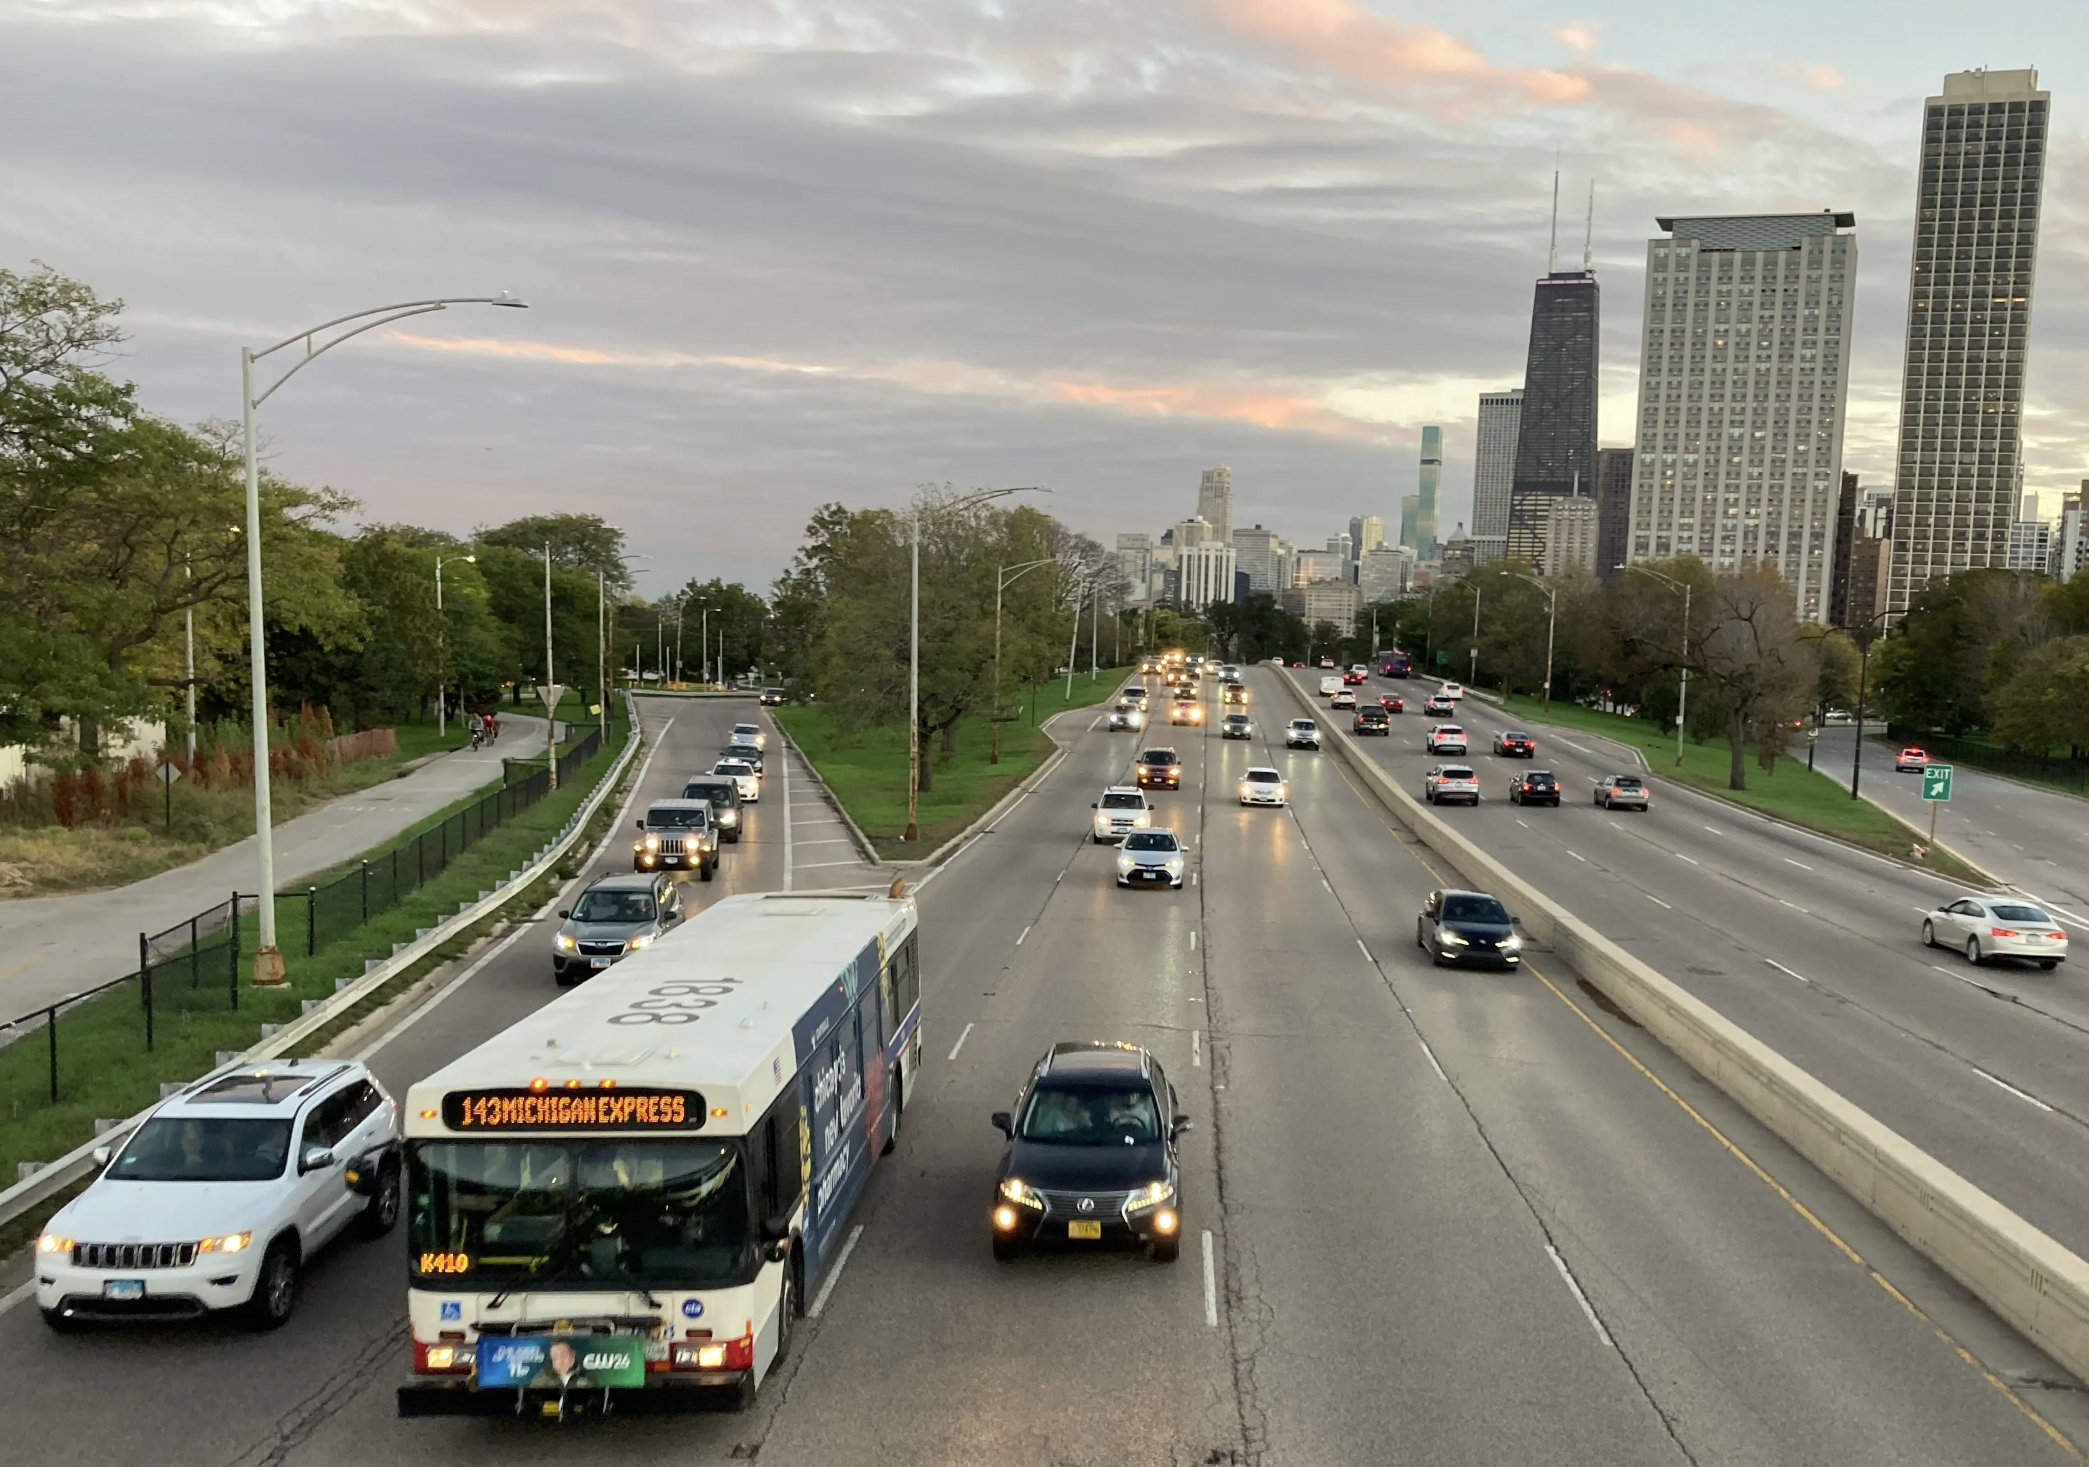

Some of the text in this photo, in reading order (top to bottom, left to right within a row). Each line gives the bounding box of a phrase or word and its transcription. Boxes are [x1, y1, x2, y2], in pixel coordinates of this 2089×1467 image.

[1925, 768, 1951, 779] EXIT
[462, 1096, 685, 1126] 143 MICHIGAN EXPRESS
[817, 1139, 850, 1219] pharmacy
[421, 1253, 468, 1273] K410
